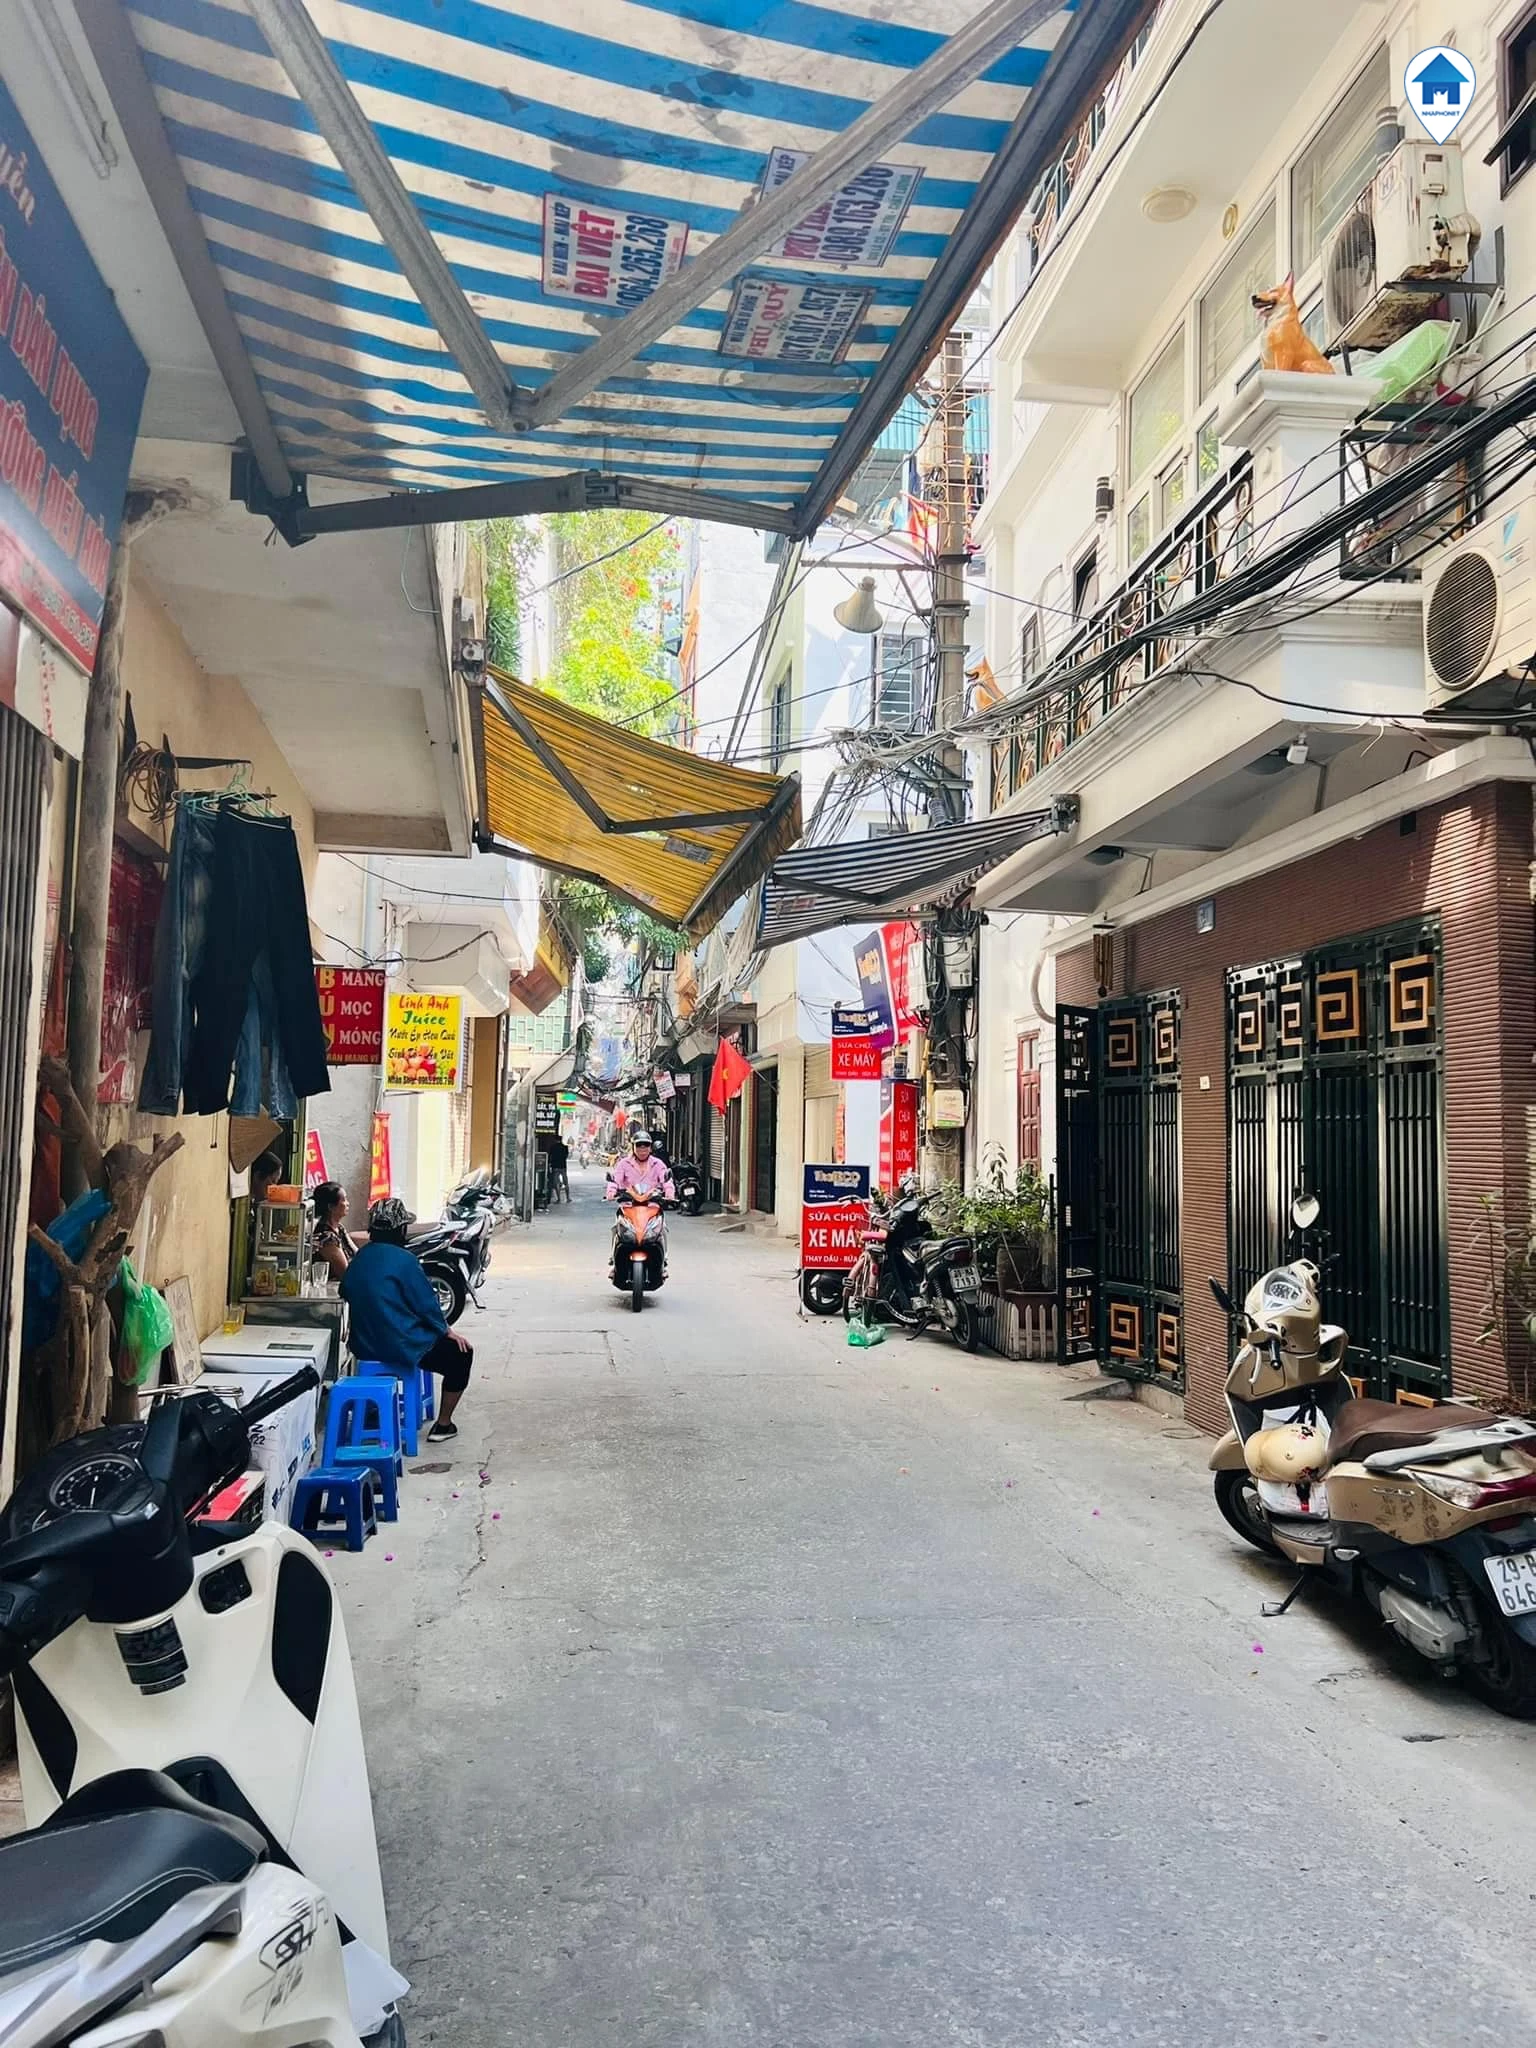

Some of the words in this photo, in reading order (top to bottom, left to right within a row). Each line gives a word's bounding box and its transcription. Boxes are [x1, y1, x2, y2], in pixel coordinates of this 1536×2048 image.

[774, 154, 795, 171] XẾP
[571, 209, 621, 258] VIỆT
[10, 281, 57, 397] DÂN
[49, 345, 99, 463] DỤNG
[340, 1001, 372, 1020] MỌC
[399, 995, 423, 1009] Linh
[427, 995, 450, 1009] Anh
[402, 1011, 446, 1025] Juice
[339, 1027, 381, 1046] MÓNG
[837, 1053, 851, 1066] XE
[852, 1052, 876, 1067] MÁY
[808, 1211, 832, 1221] SỬA
[808, 1228, 828, 1247] XE
[805, 1255, 822, 1263] THAY
[823, 1254, 839, 1263] DẦU
